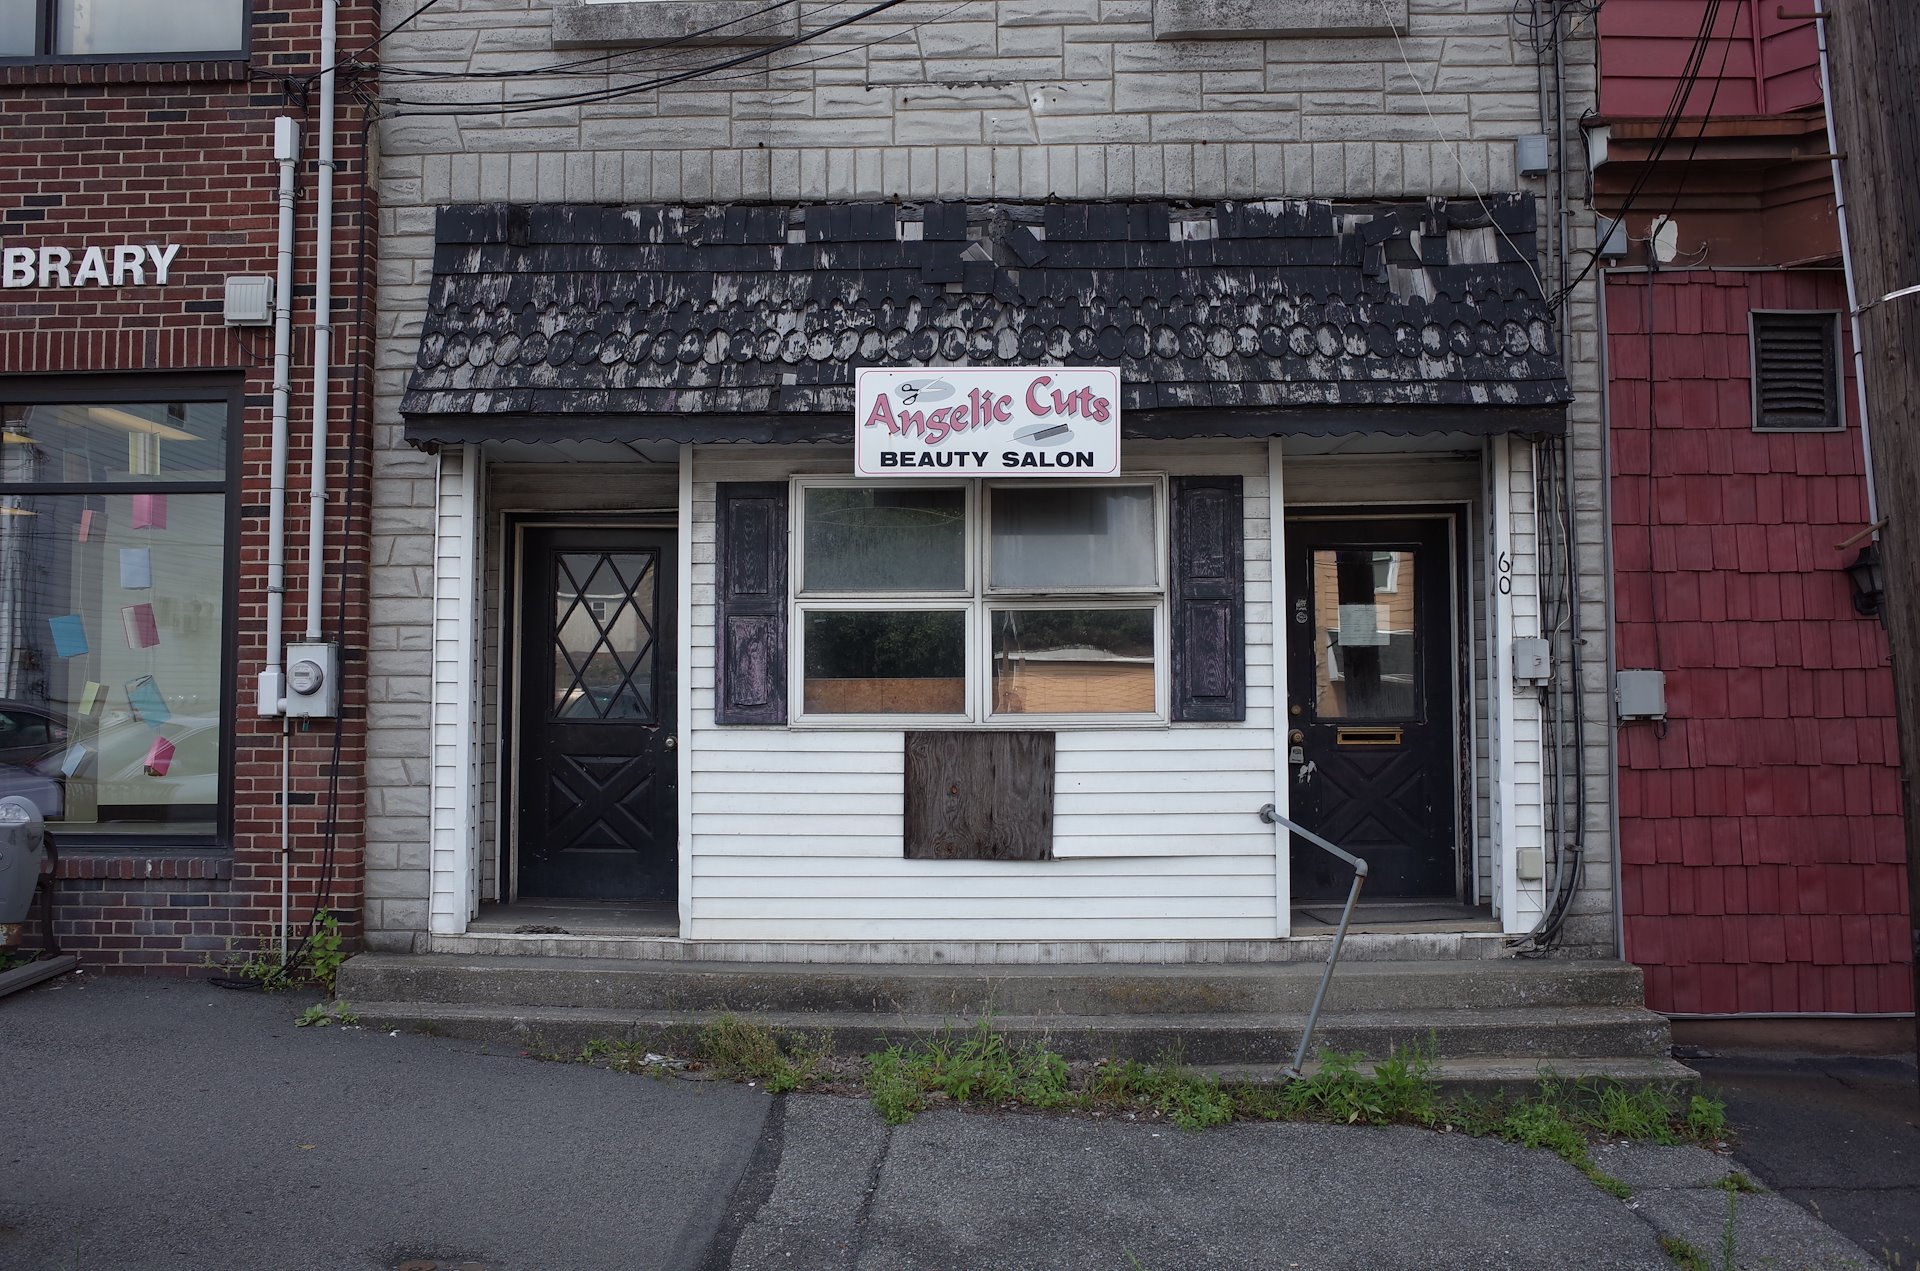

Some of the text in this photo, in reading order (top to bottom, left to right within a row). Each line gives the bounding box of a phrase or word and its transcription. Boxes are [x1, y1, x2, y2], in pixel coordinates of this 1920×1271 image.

[3, 244, 180, 288] BRARY
[864, 375, 1111, 445] Angelic Cuts
[880, 451, 1094, 467] BEAUTY SALON
[1498, 551, 1511, 595] 60
